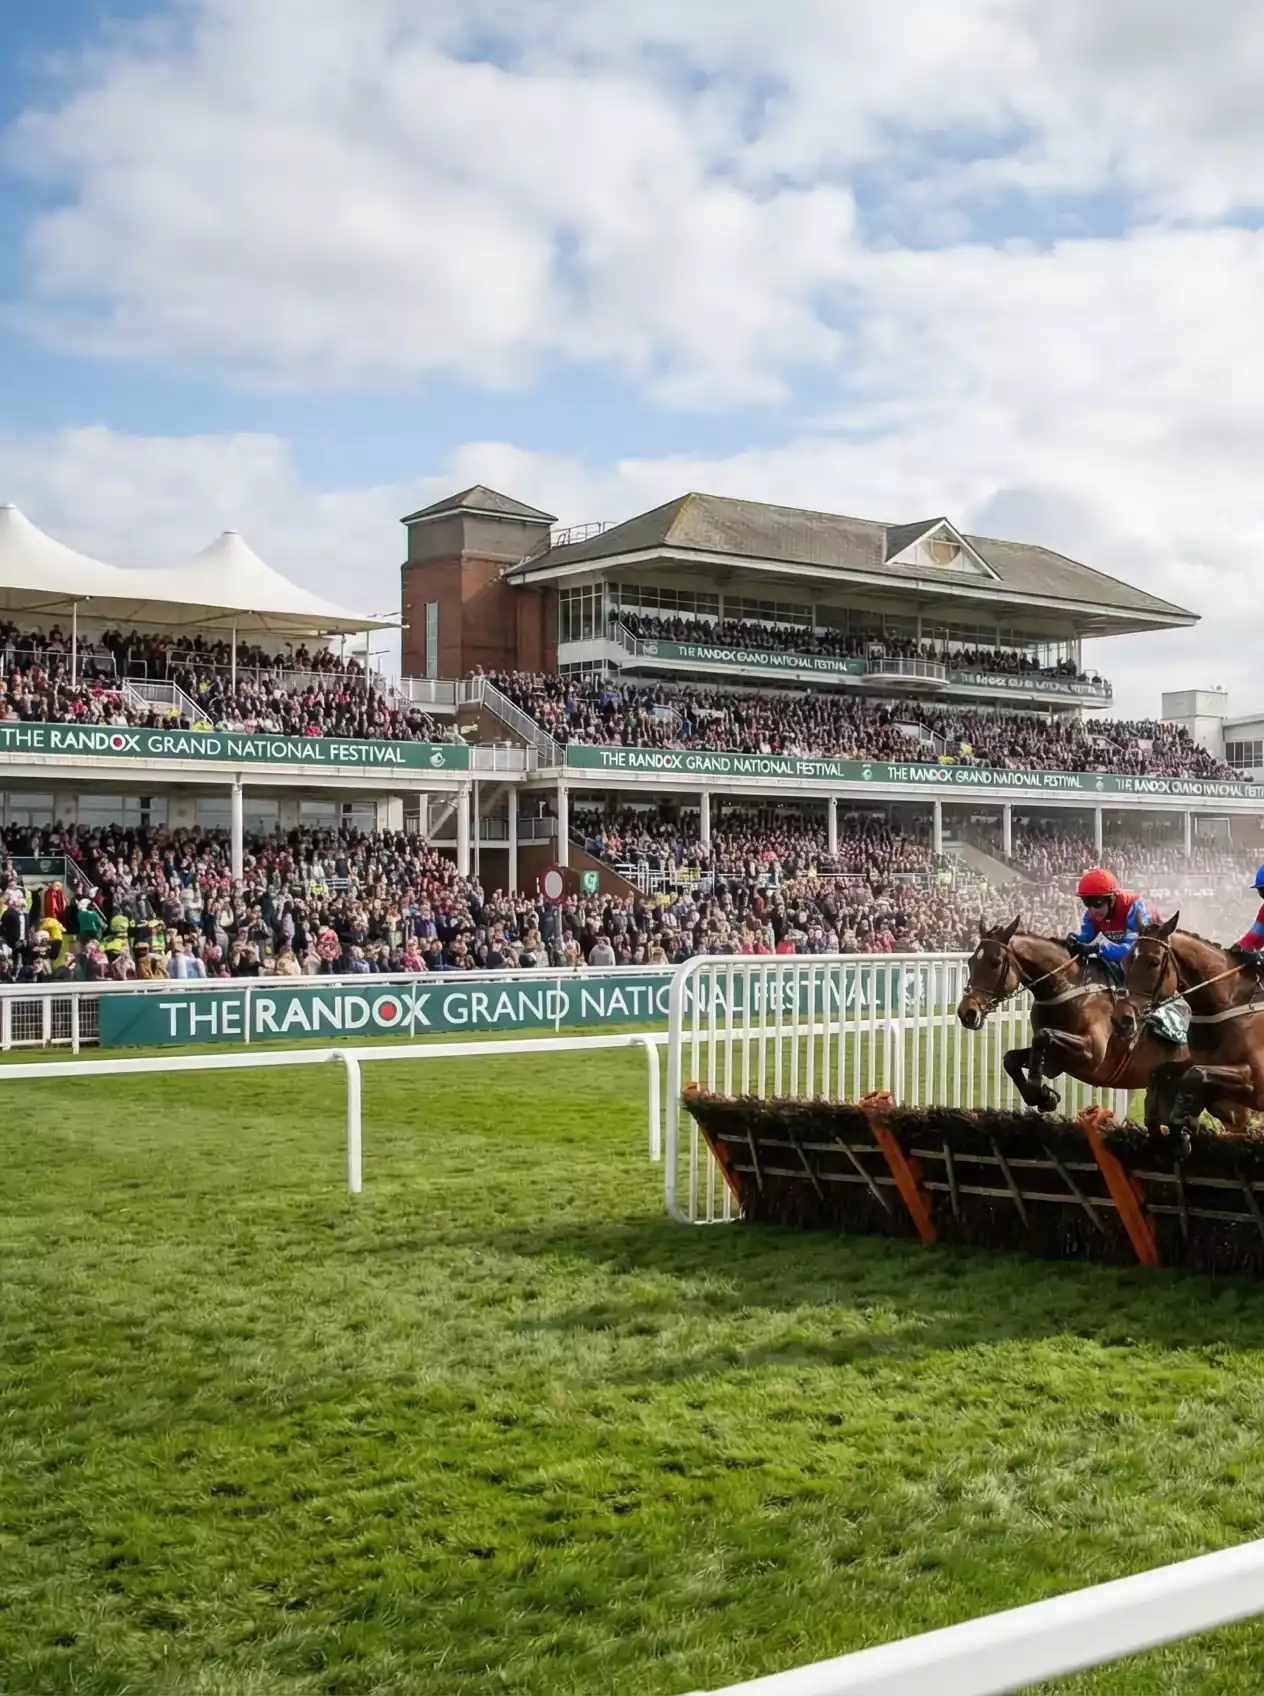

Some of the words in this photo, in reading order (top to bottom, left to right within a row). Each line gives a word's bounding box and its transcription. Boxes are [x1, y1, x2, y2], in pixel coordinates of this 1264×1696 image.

[1, 728, 45, 747] THE
[50, 731, 141, 751] RANDOX
[148, 735, 221, 755] GRAND
[227, 739, 325, 760] NATIONAL
[330, 744, 406, 763] FESTIVAL
[600, 751, 626, 766] THE
[629, 753, 683, 769] RANDOX
[686, 756, 731, 771] GRAND
[734, 758, 793, 774] NATIONAL
[796, 762, 844, 777] FESTIVAL
[888, 766, 908, 780] THE
[956, 770, 992, 784] GRAND
[159, 1000, 241, 1037] THE
[256, 992, 432, 1033] RANDOX
[442, 989, 570, 1025] GRAND
